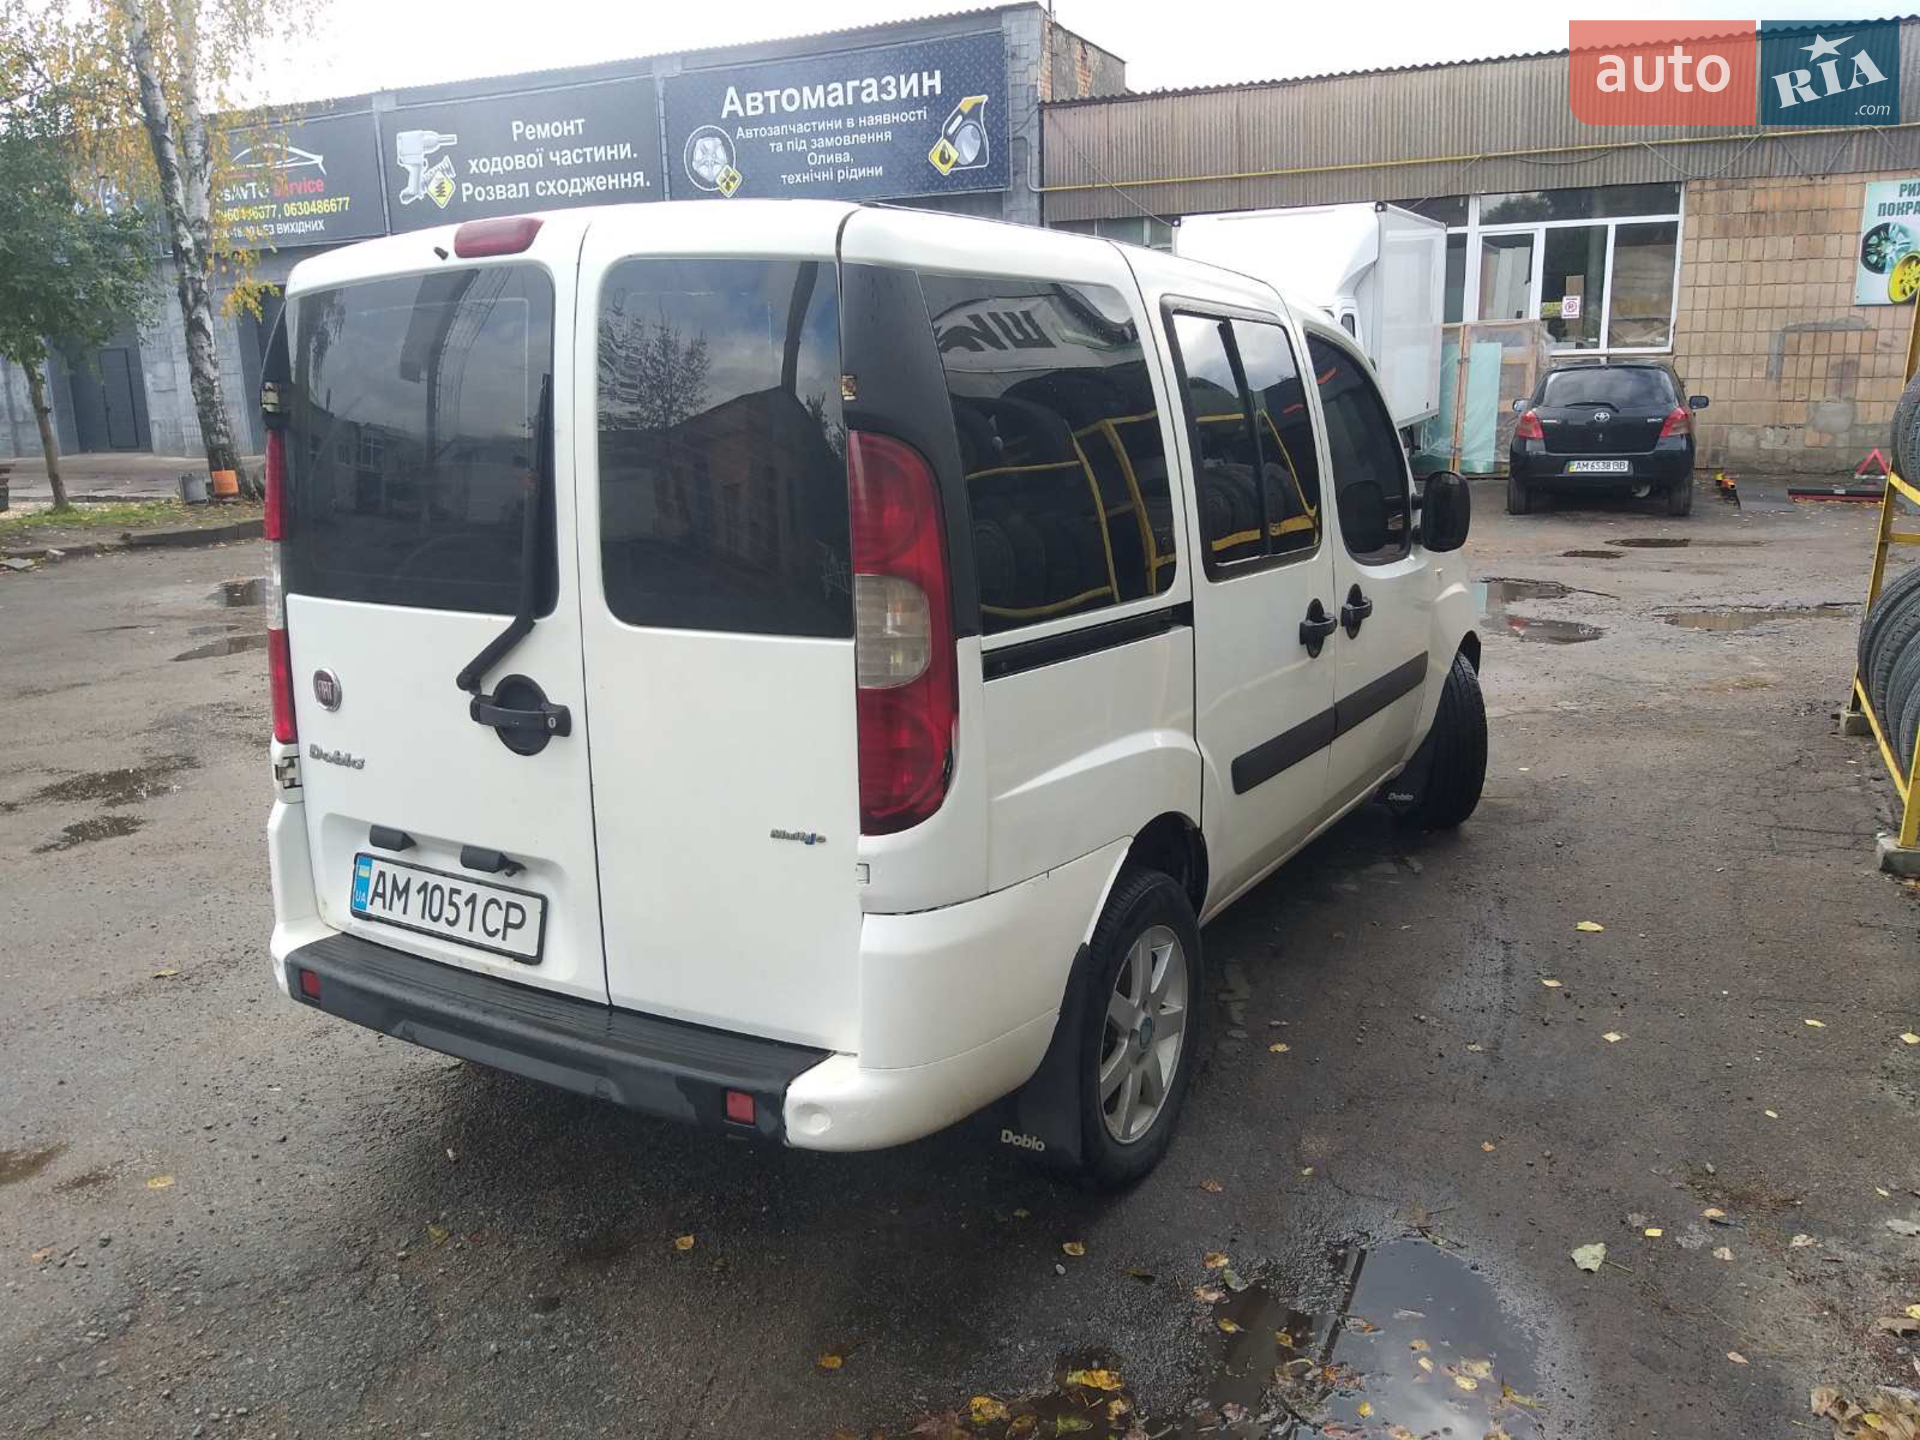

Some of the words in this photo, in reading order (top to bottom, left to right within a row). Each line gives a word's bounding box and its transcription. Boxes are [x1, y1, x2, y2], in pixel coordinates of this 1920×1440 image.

[720, 70, 942, 119] Автомагазин
[511, 118, 586, 141] Ремонт
[735, 118, 842, 140] Автозапчастини
[846, 117, 855, 128] в
[858, 106, 928, 127] наявності
[769, 140, 783, 153] та
[786, 137, 807, 155] під
[810, 130, 892, 149] замовлення
[468, 147, 544, 175] ходової
[549, 143, 638, 168] частини.
[807, 152, 854, 166] Олива,
[461, 181, 530, 202] Розвал
[535, 171, 651, 197] сходження.
[781, 167, 834, 186] технічні
[836, 165, 883, 184] рідини
[283, 196, 350, 217] 0630486677
[276, 219, 325, 235] ВИХІДНИХ
[355, 890, 368, 904] UA
[1001, 1129, 1046, 1151] Doblo
